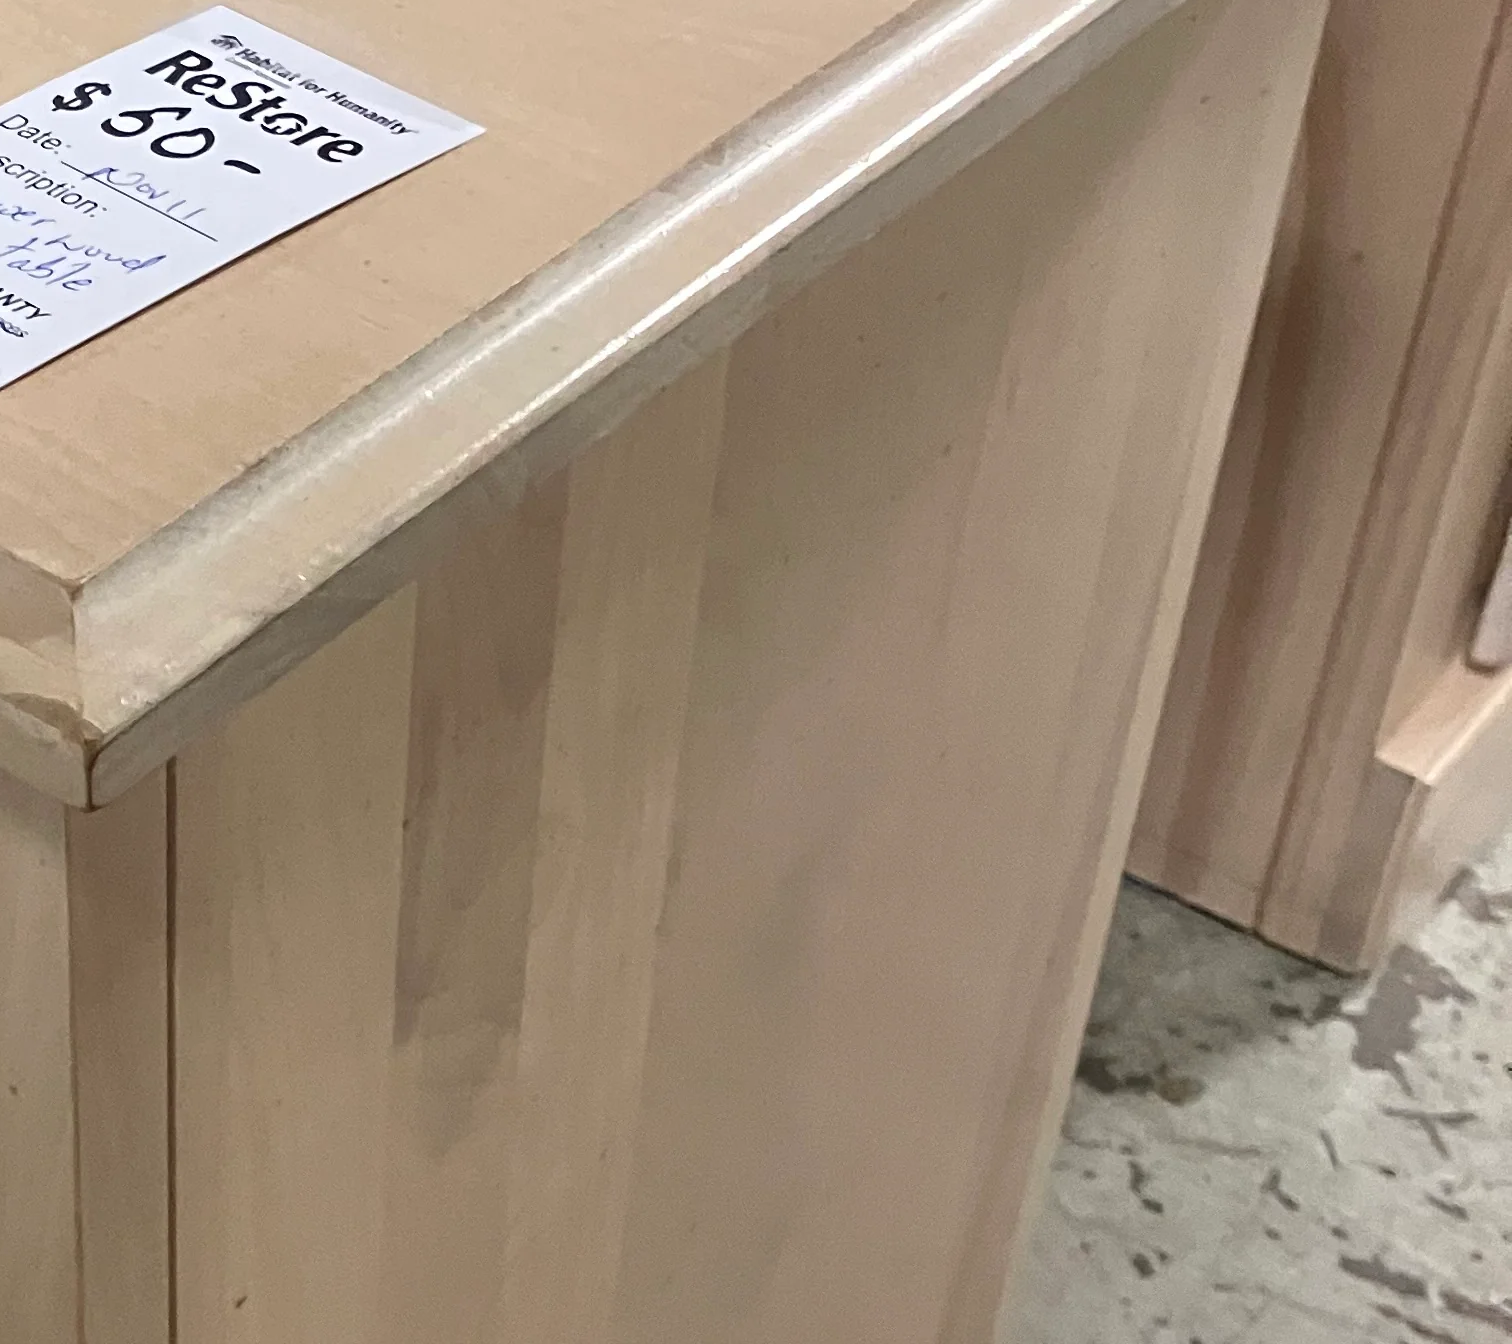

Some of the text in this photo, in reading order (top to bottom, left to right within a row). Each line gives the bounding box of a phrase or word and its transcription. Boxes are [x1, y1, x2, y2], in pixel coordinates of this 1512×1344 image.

[141, 49, 365, 164] ReStore
[234, 47, 302, 82] Habitat
[297, 78, 329, 94] for
[324, 90, 416, 136] Humanity
